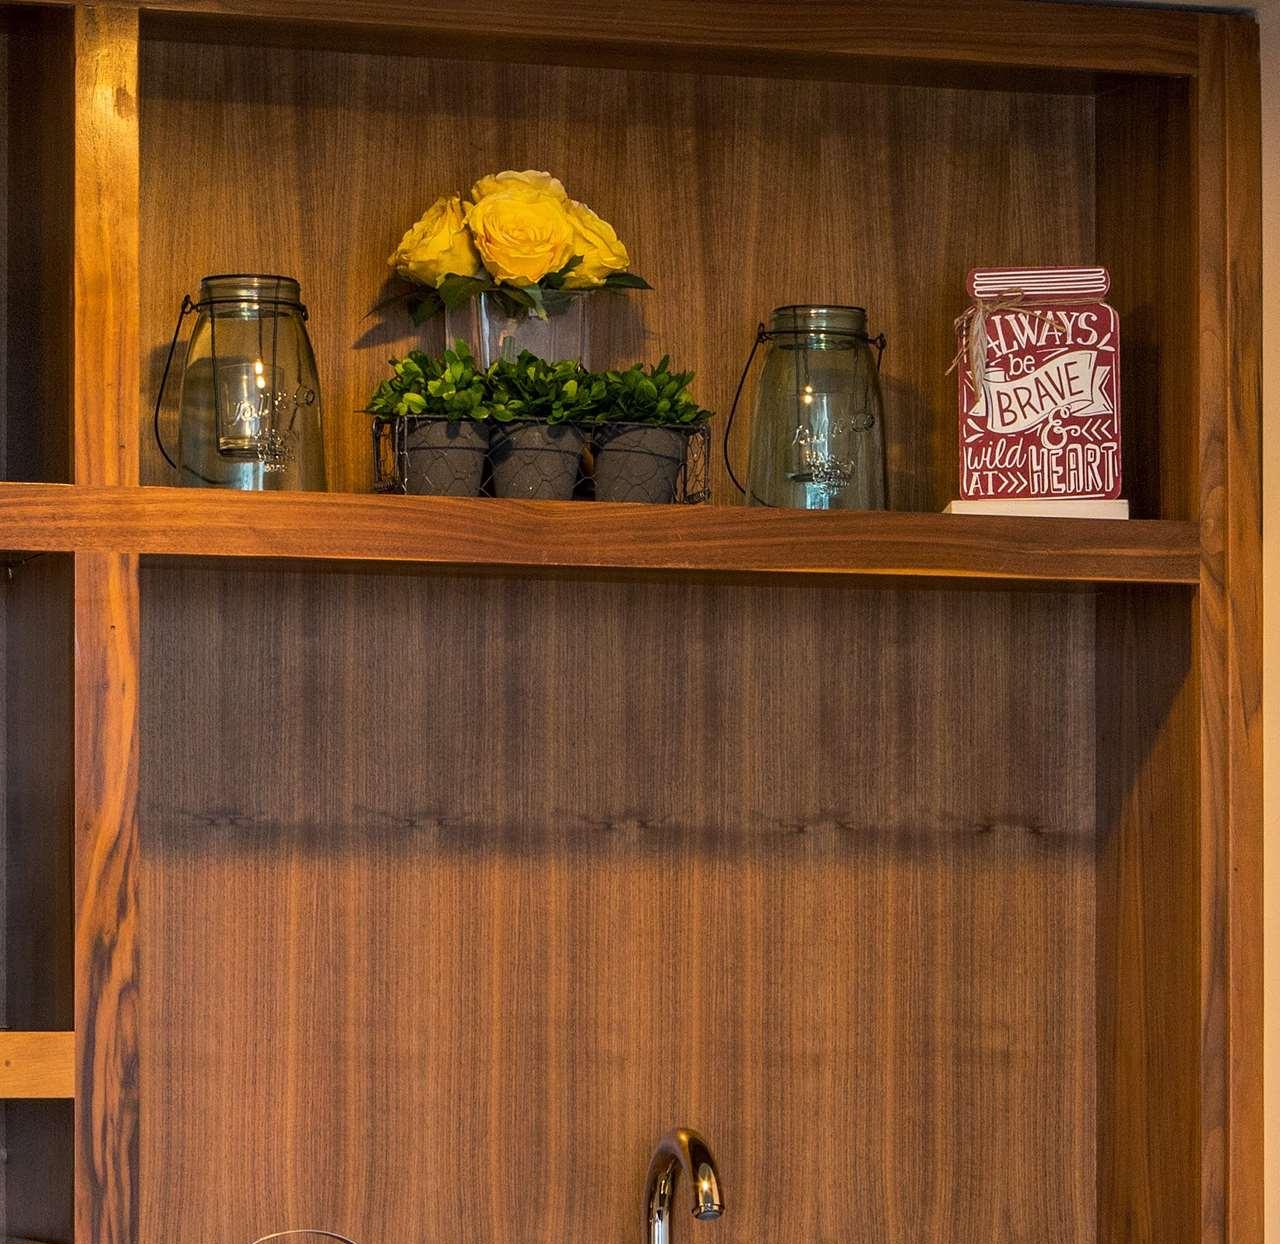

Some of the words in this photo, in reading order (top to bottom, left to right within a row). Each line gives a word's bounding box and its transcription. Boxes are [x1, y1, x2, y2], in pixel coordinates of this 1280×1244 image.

[1009, 354, 1036, 376] be
[996, 361, 1084, 427] BRAVE
[967, 436, 1028, 469] wild
[1028, 442, 1118, 494] HEART
[968, 471, 999, 496] AT
